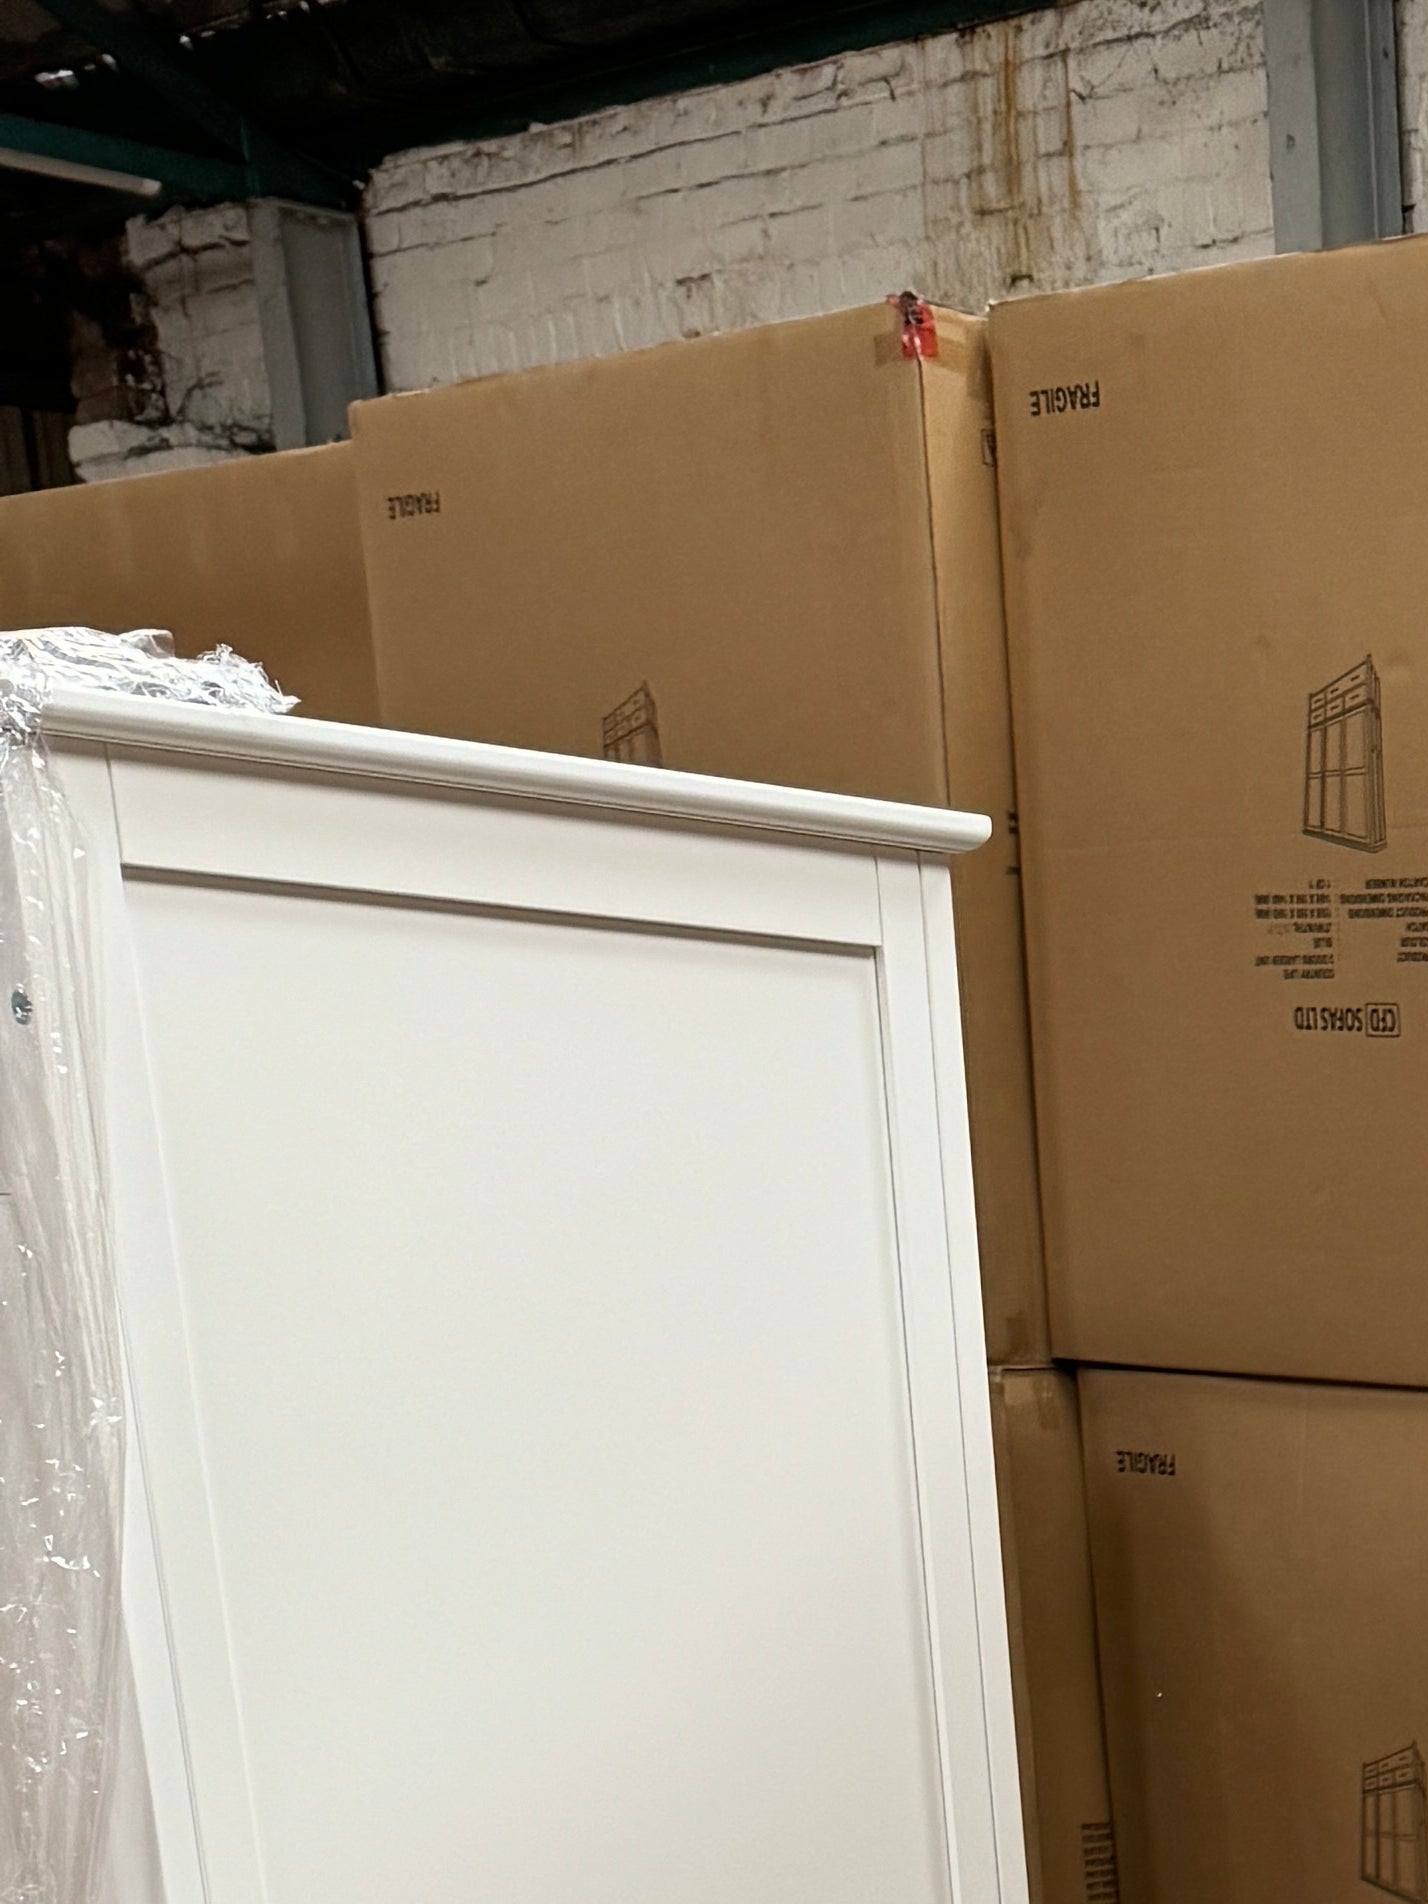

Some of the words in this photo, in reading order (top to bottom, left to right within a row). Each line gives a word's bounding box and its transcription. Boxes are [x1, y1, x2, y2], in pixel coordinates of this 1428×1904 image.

[1029, 380, 1100, 417] FRAGILE
[1294, 1007, 1317, 1031] LTD
[1321, 1007, 1363, 1032] SOFAS
[1370, 1008, 1396, 1032] CFD
[1115, 1451, 1176, 1476] FRAGILE
